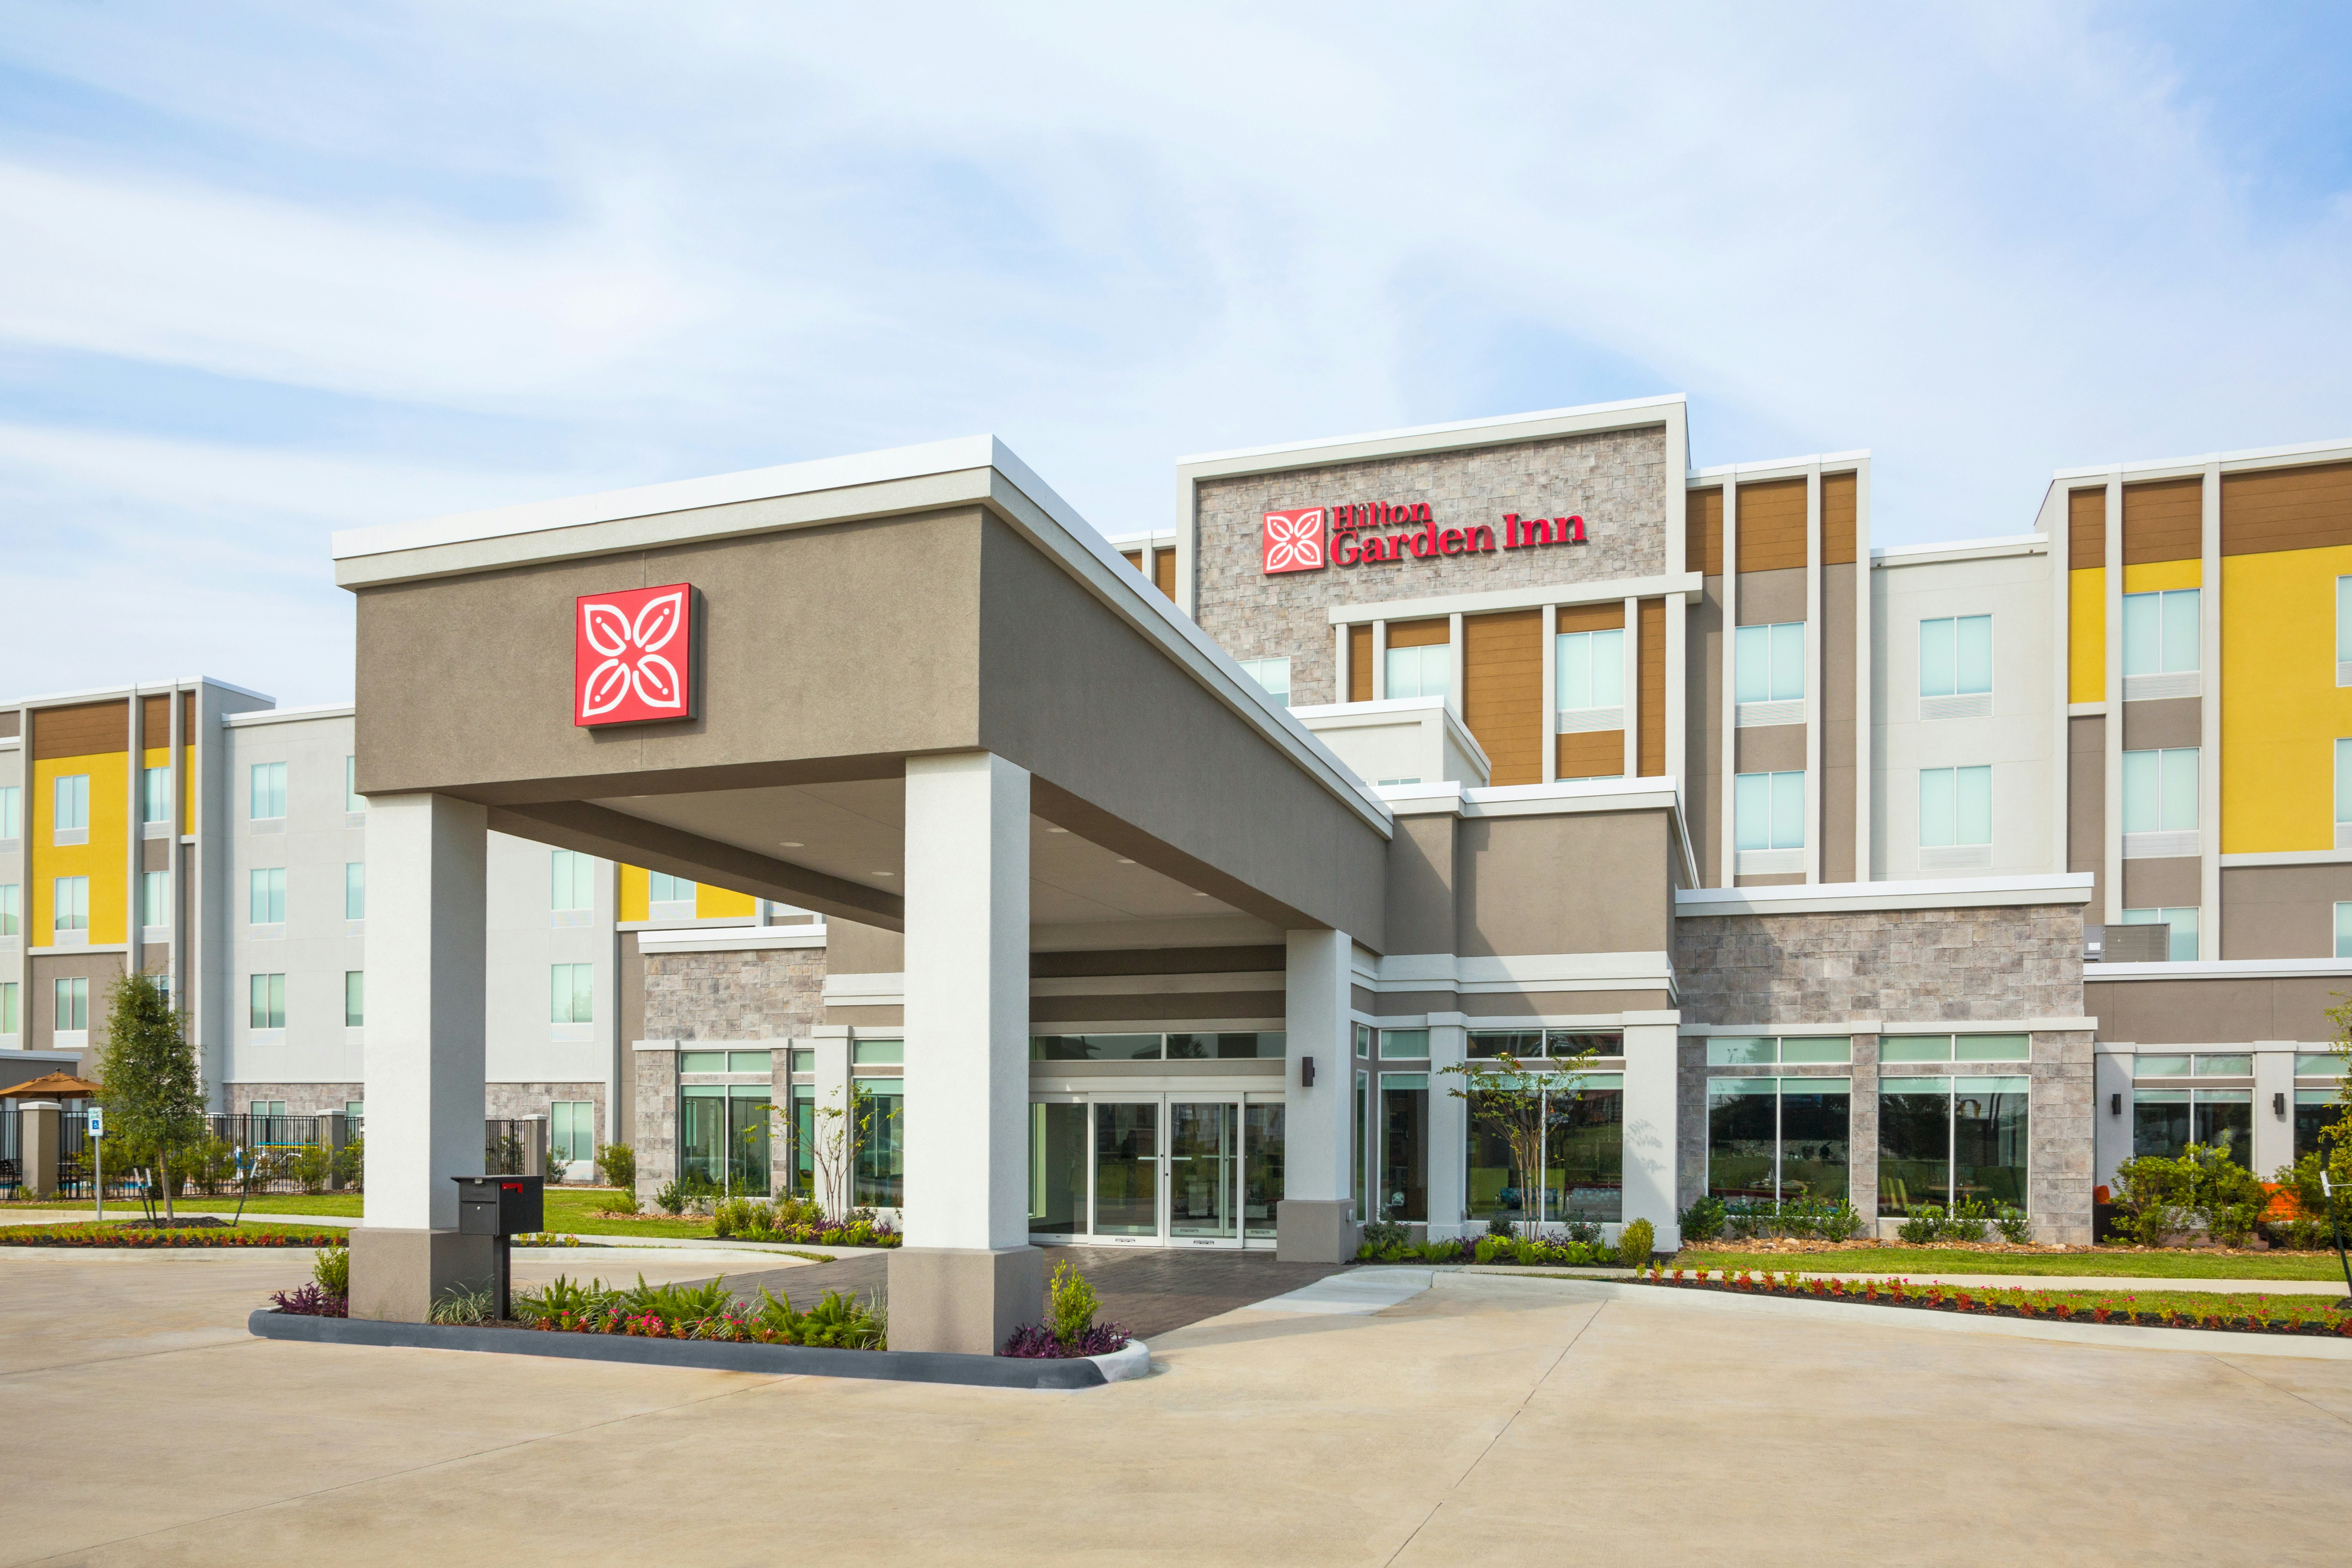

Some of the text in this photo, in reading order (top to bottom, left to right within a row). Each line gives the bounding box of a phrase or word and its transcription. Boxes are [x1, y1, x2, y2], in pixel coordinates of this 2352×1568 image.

[1331, 501, 1432, 530] Hilton
[1330, 514, 1587, 565] Garden Inn
